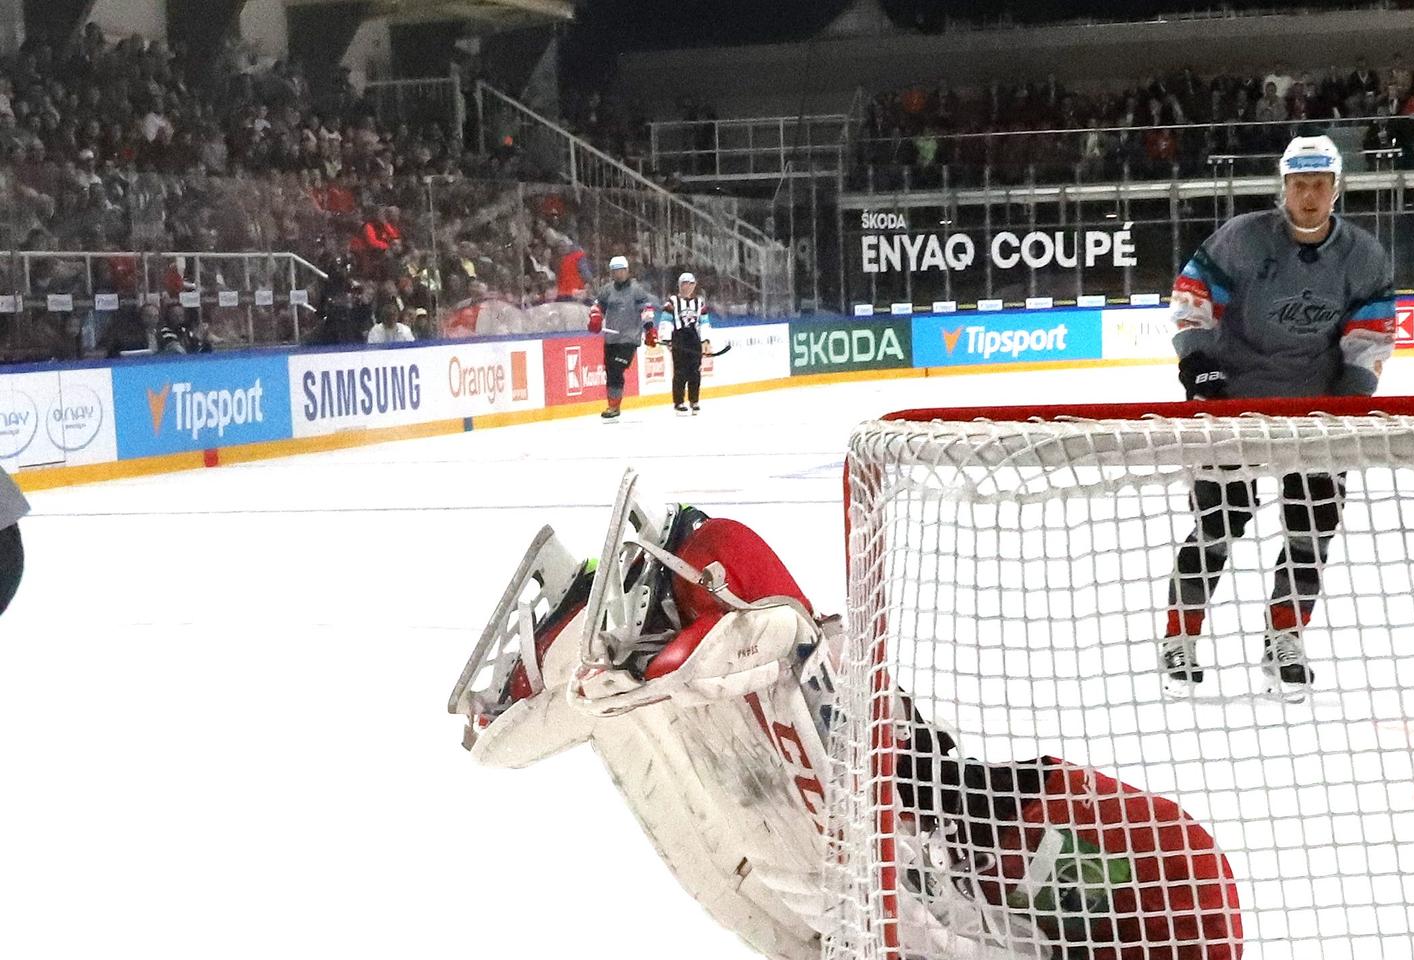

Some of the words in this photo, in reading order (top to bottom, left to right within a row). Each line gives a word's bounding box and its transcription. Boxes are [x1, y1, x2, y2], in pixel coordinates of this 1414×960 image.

[861, 209, 907, 230] ŠKODA
[861, 233, 975, 273] ENYAQ
[991, 222, 1137, 270] COUPÉ
[966, 323, 1069, 360] Tipsport
[303, 363, 421, 422] SAMSUNG
[448, 355, 505, 404] Orange
[172, 377, 263, 440] Tipsport
